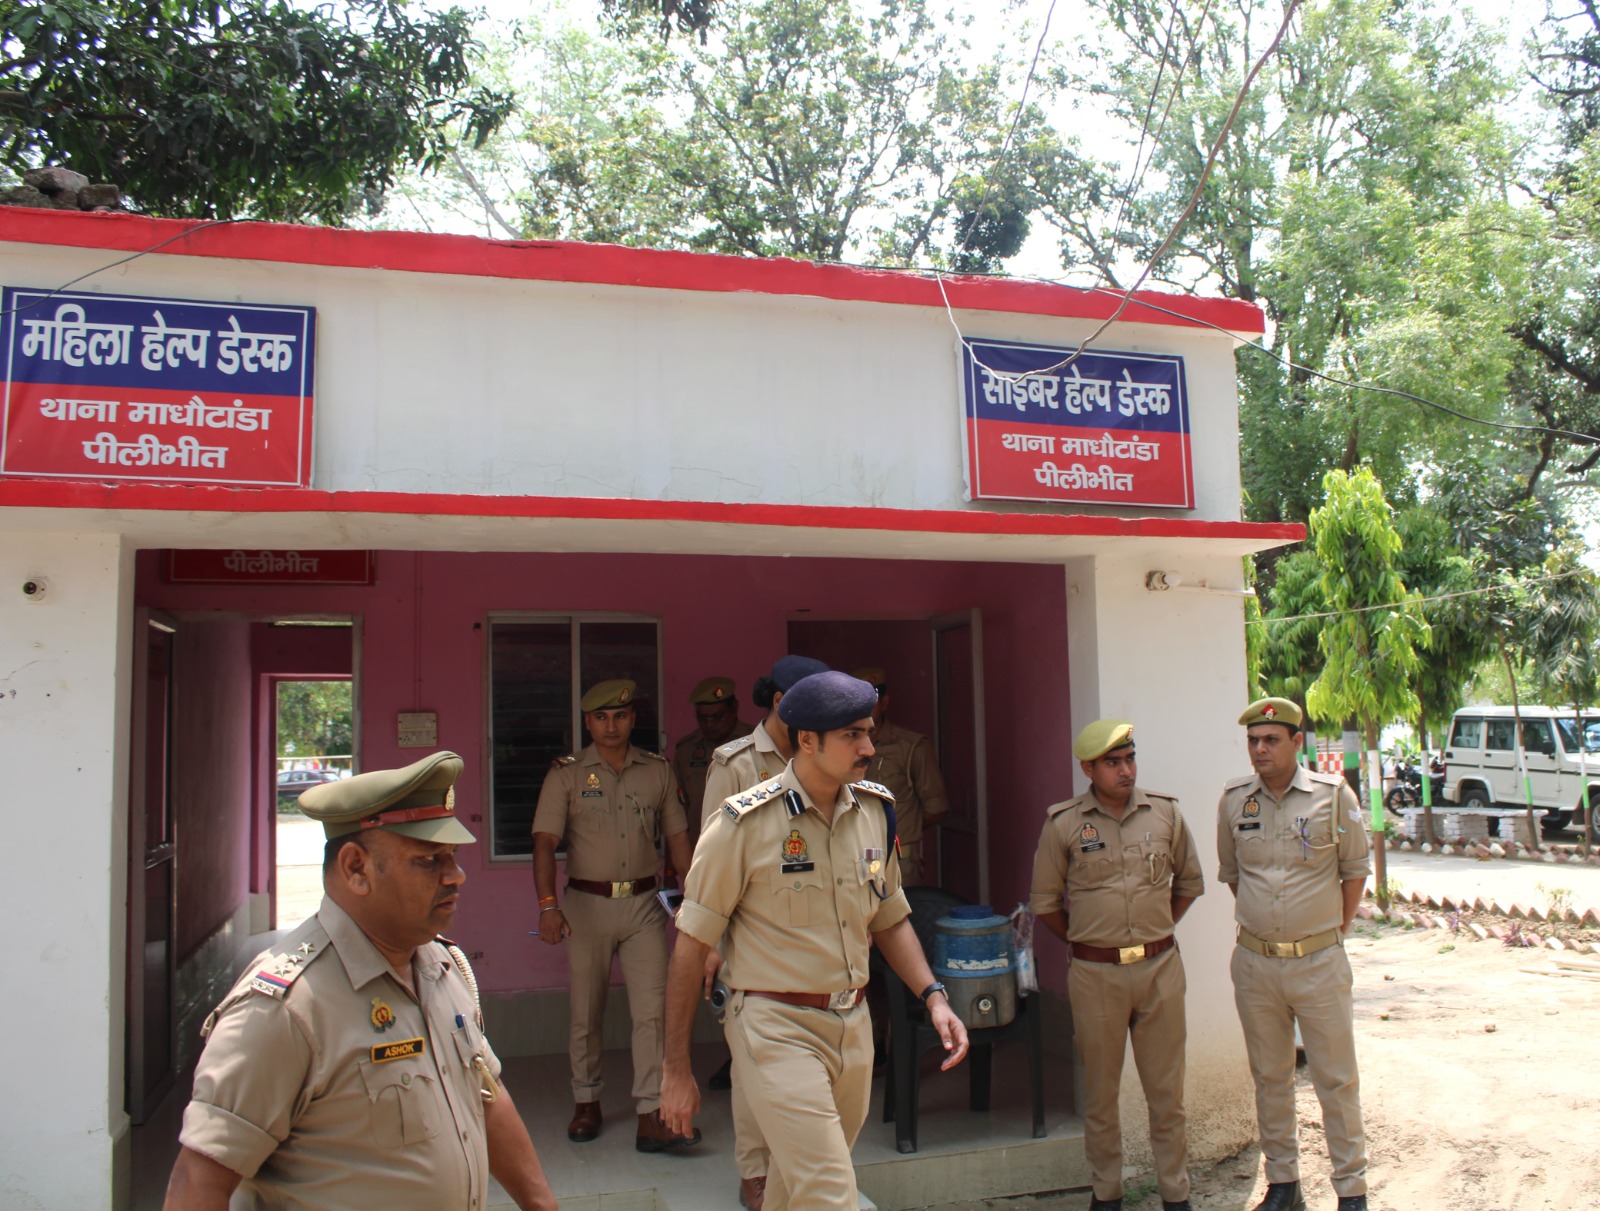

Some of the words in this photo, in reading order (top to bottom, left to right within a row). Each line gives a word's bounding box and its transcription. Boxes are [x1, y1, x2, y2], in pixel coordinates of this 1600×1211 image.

[22, 303, 134, 367] महिला
[140, 310, 211, 372] हेल्प
[216, 315, 297, 375] डेस्क
[981, 369, 1060, 412] साइबर
[1064, 364, 1112, 415] हेल्प
[1116, 368, 1172, 417] डेस्क
[40, 398, 121, 423] थाना
[128, 395, 272, 432] माधौटांडा
[82, 432, 229, 469] पीलीभीत
[1001, 433, 1056, 454] थाना
[1060, 432, 1160, 461] माधौटांडा
[1034, 461, 1134, 492] पीलीभीत
[223, 550, 320, 574] पीलीभीत
[384, 1043, 415, 1058] ASHOK
